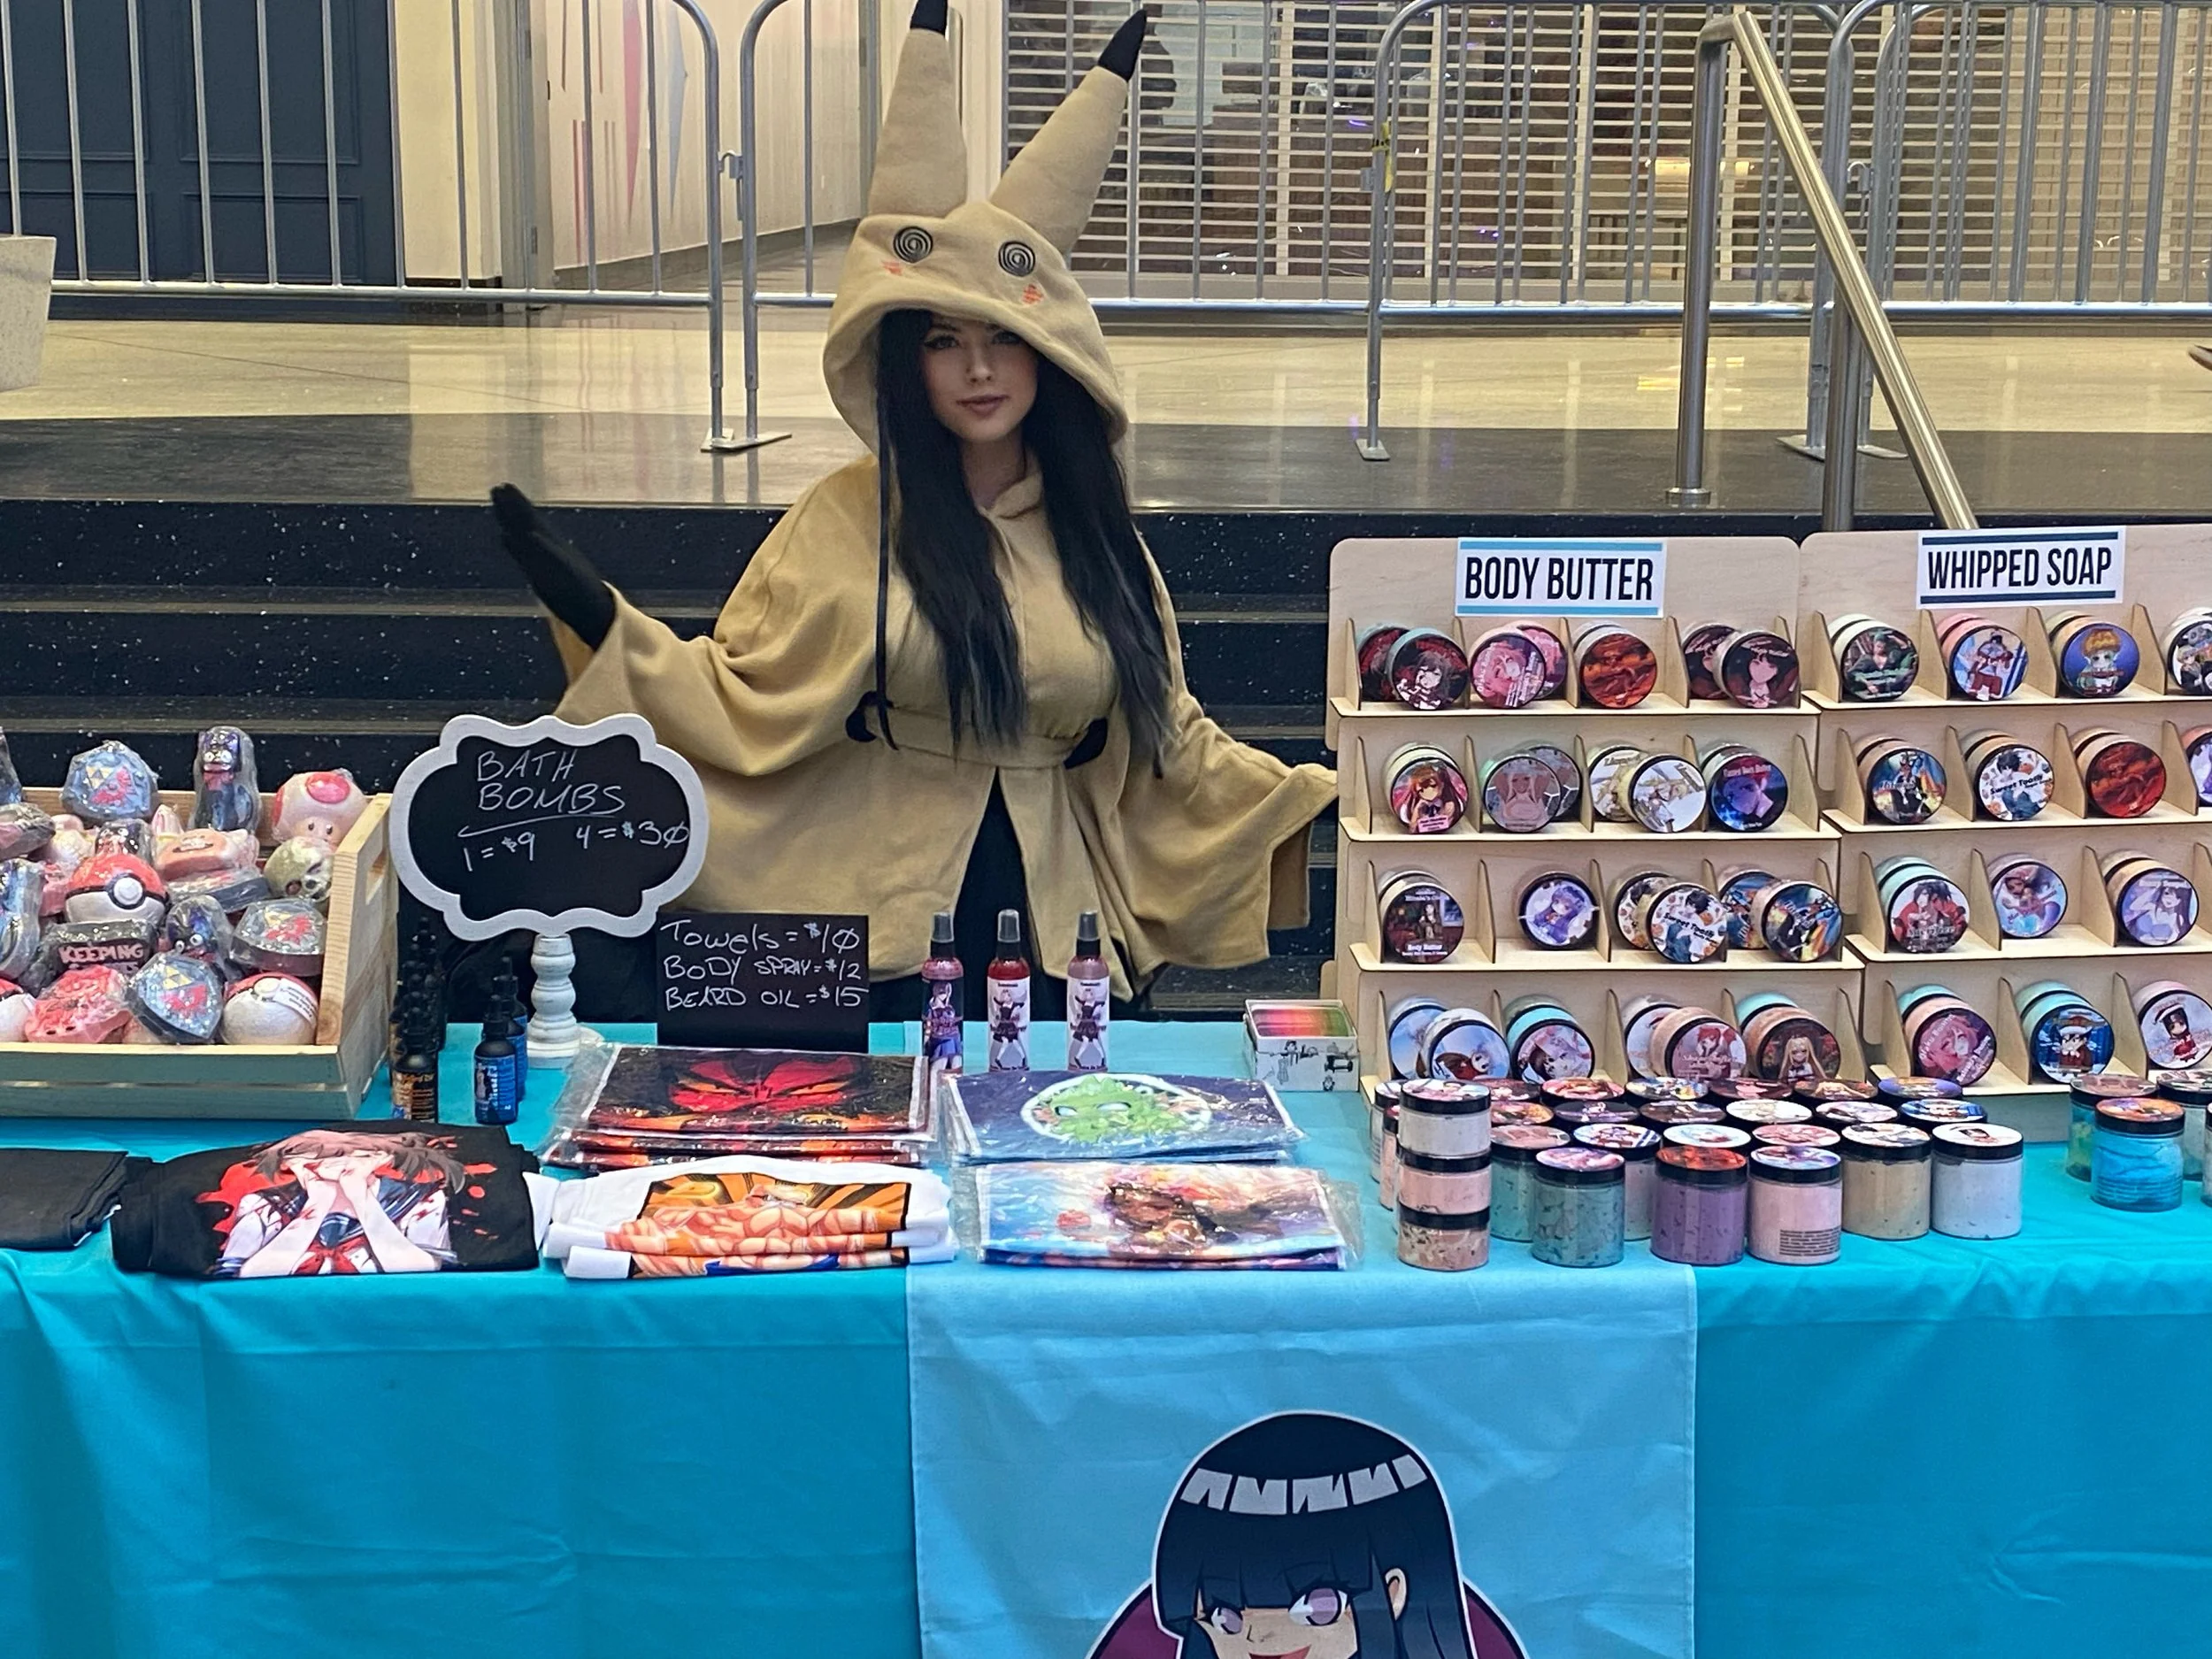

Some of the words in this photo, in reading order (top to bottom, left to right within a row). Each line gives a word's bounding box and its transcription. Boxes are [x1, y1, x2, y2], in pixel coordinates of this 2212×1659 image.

[1464, 556, 1540, 600] BODY
[1547, 557, 1654, 601] BUTTER
[1927, 549, 2040, 589] WHIPPED
[2047, 546, 2112, 587] SOAP
[477, 749, 578, 782] BATH
[479, 782, 626, 815] BOMBS
[58, 943, 143, 964] KEEPING
[660, 919, 780, 955] Towels
[664, 955, 741, 986] BODY
[664, 986, 747, 1012] BEARD
